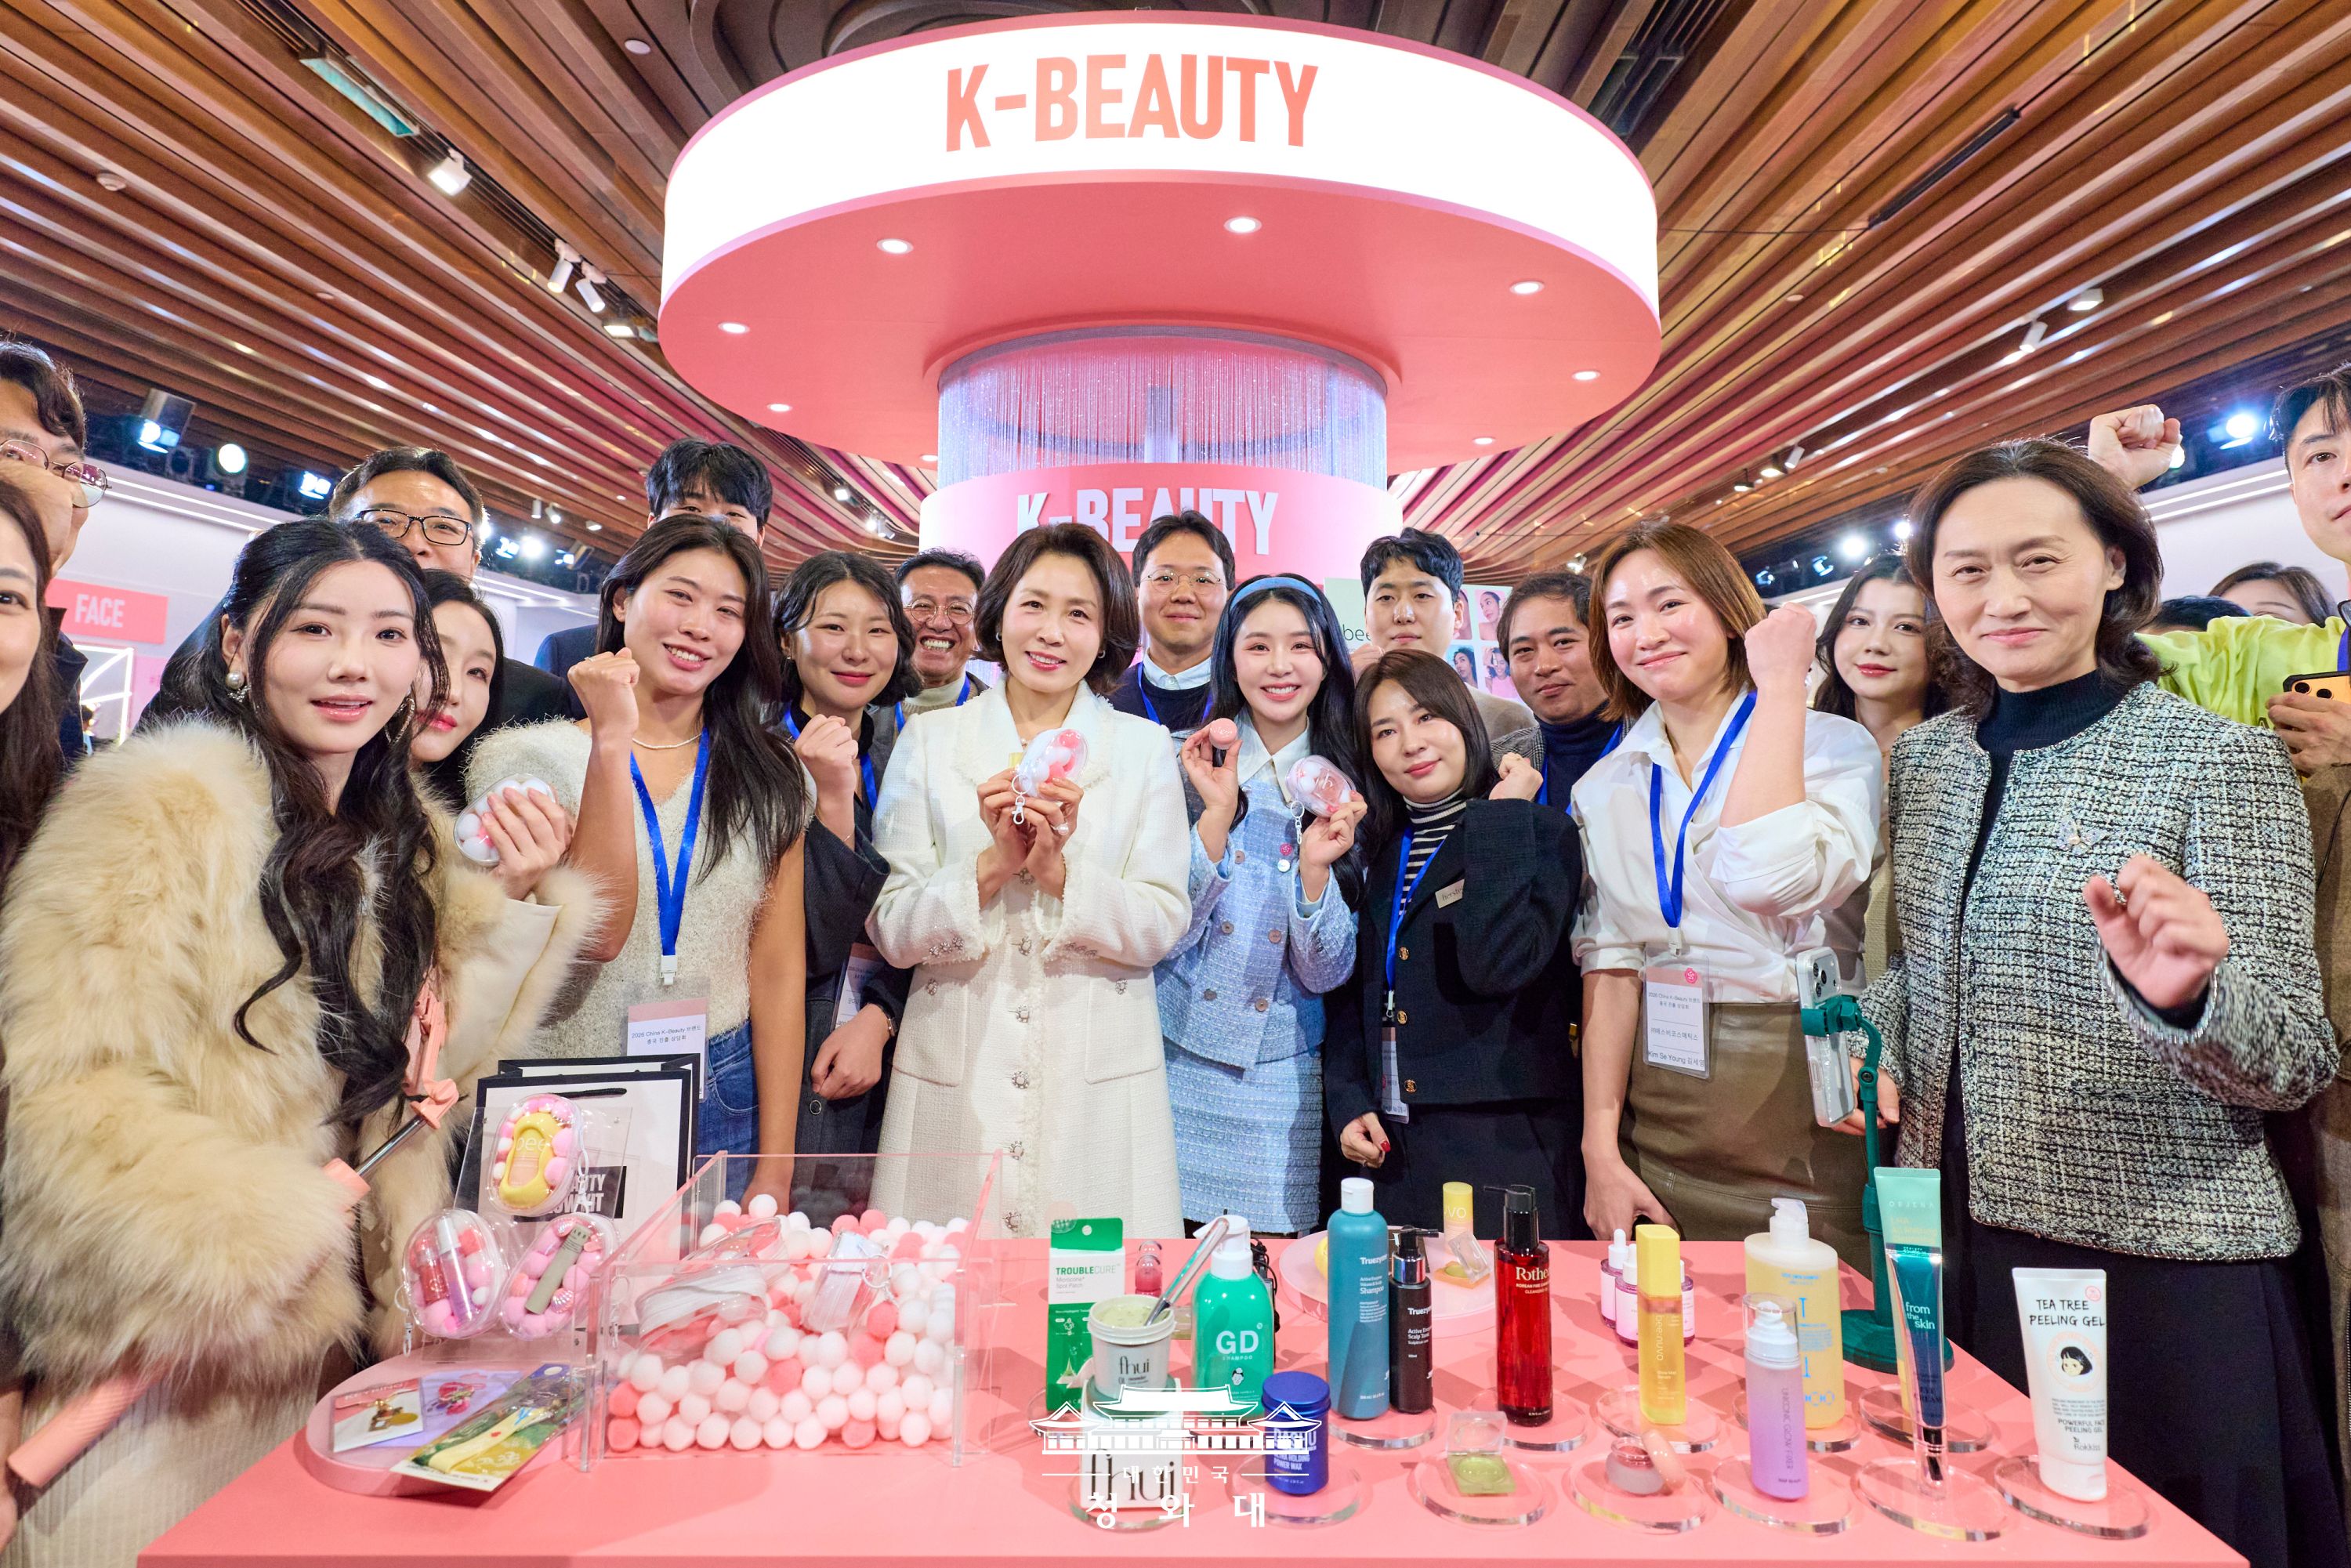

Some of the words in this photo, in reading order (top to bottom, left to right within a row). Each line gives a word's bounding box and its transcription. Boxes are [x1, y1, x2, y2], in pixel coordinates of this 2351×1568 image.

[946, 53, 1319, 152] K-BEAUTY
[74, 593, 125, 628] FACE
[1668, 1054, 1686, 1064] Young
[1056, 1265, 1117, 1276] TROUBLECURE
[1360, 1285, 1385, 1295] Shampoo
[1905, 1302, 1930, 1315] from
[2036, 1299, 2056, 1311] TEA
[2059, 1299, 2090, 1311] TREE
[1914, 1320, 1936, 1330] skin
[2029, 1315, 2078, 1327] PEELING
[2082, 1316, 2106, 1327] GEL
[1216, 1331, 1259, 1355] GD
[1120, 1356, 1150, 1374] fhui
[2058, 1418, 2093, 1427] POWERFUL
[1273, 1458, 1290, 1470] POWER
[1290, 1462, 1302, 1471] WAX
